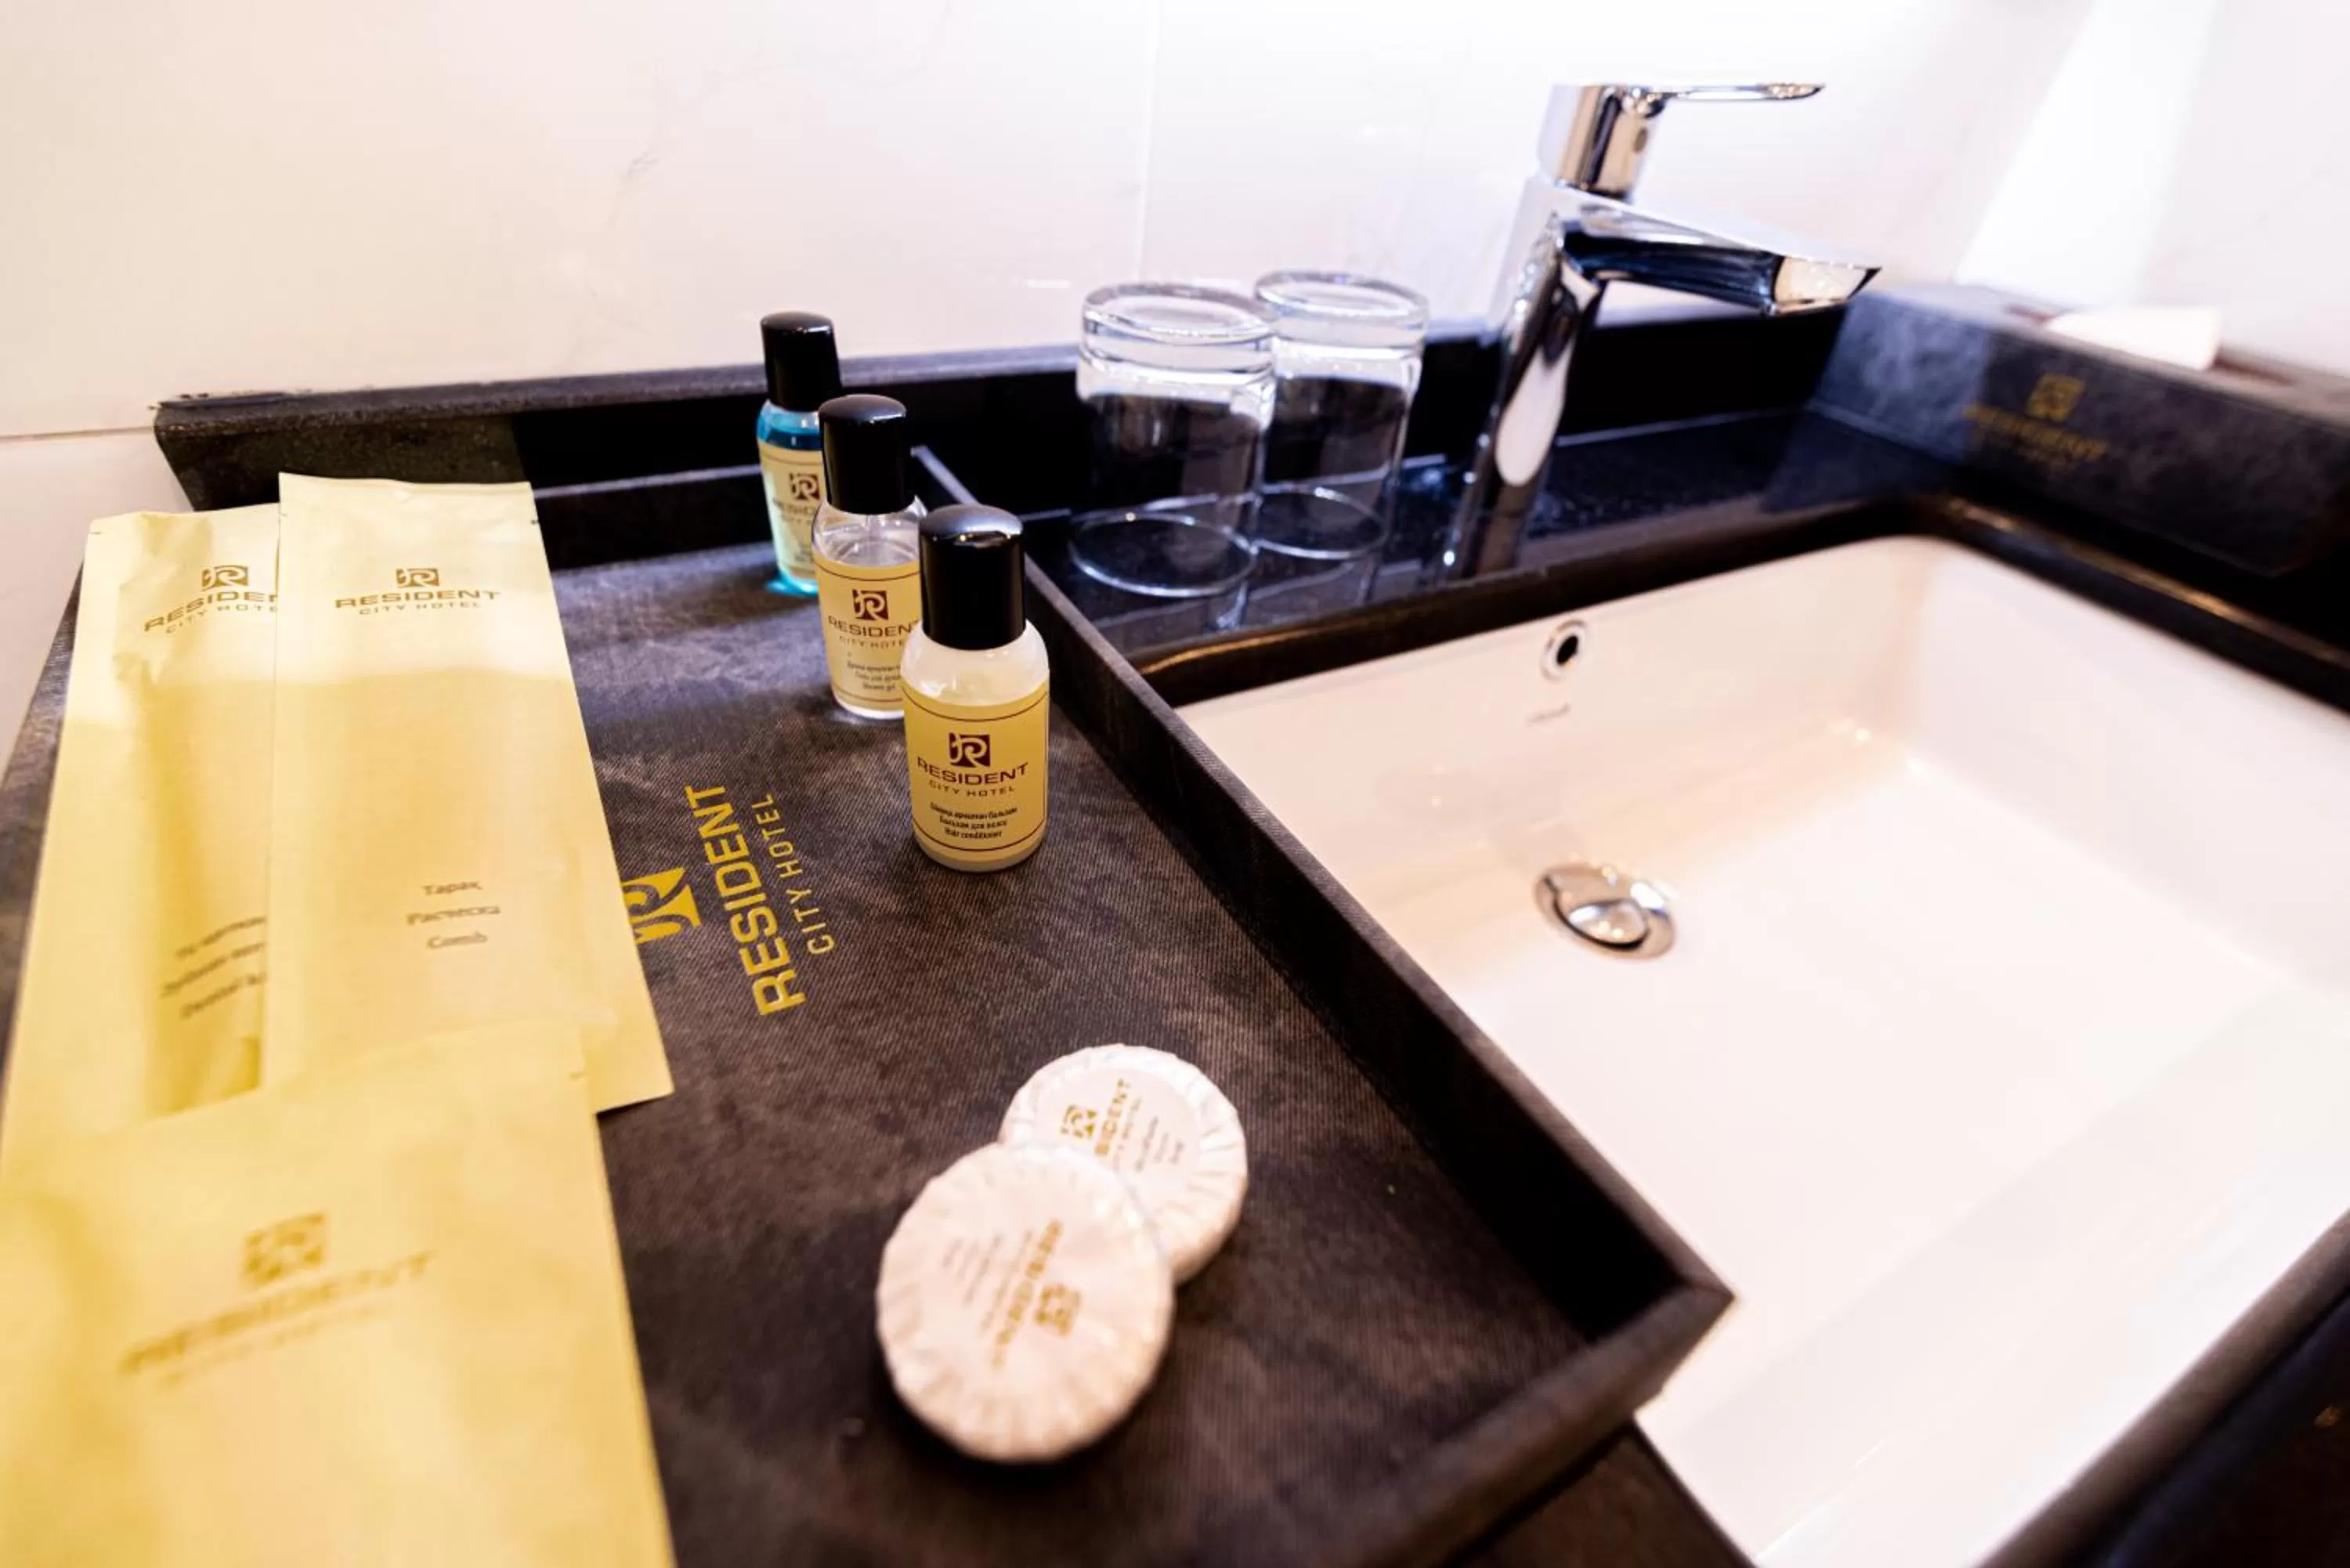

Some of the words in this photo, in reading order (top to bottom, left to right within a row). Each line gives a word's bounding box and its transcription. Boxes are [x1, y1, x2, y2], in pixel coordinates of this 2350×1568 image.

[144, 591, 278, 631] RESIDE
[216, 603, 278, 612] HOTE
[334, 589, 501, 609] RESIDENT
[359, 603, 406, 616] CITY
[415, 601, 482, 611] HOTEL
[917, 757, 1029, 786] RESIDENT
[929, 780, 960, 795] CITY
[966, 786, 1015, 797] HOTEL
[751, 793, 803, 878] HOTEL
[684, 785, 807, 1016] RESIDENT
[786, 888, 835, 955] CITY
